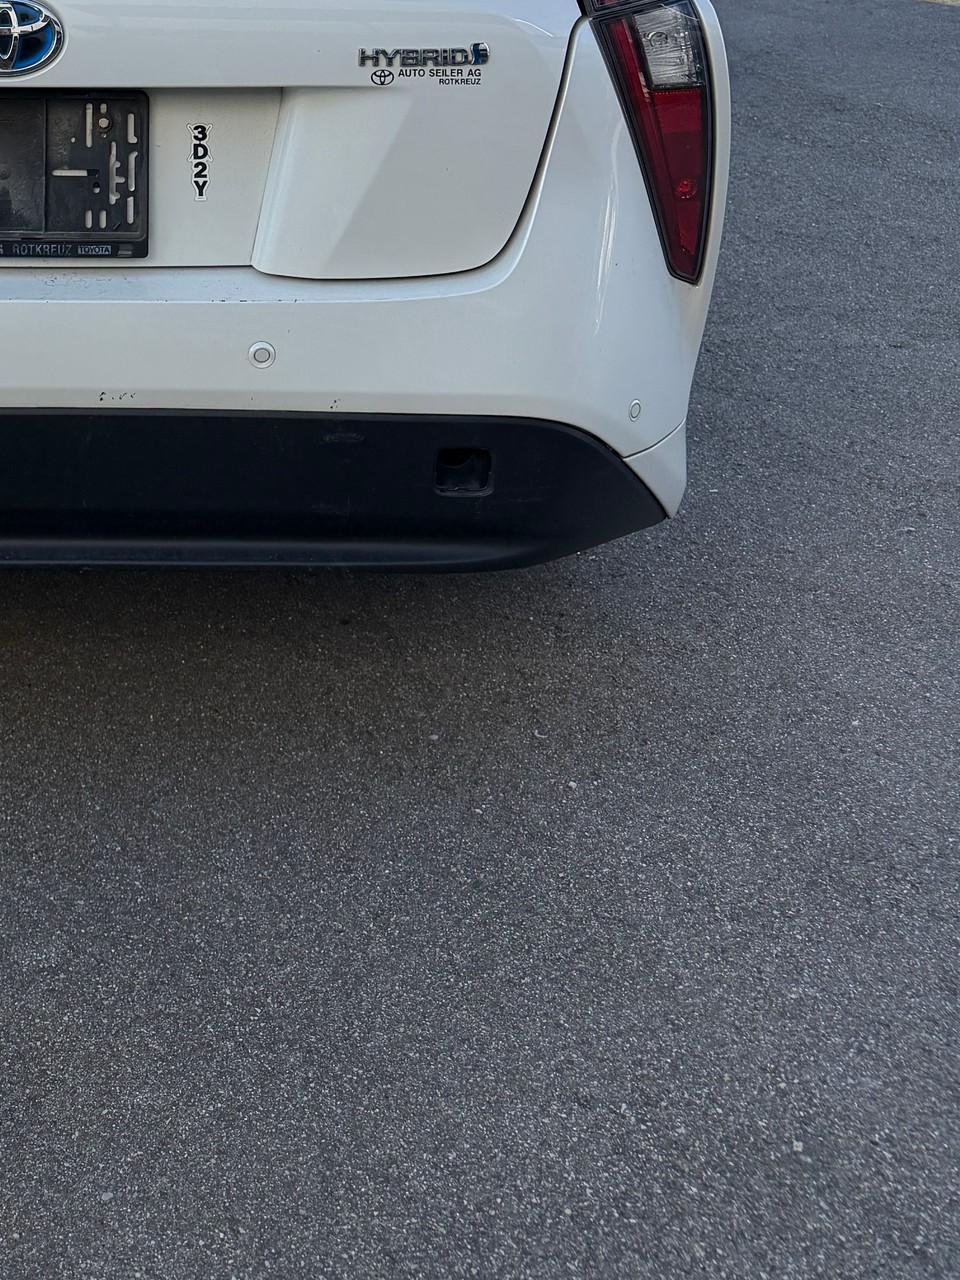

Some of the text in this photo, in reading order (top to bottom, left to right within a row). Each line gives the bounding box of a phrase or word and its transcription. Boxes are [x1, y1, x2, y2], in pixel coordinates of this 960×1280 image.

[358, 47, 469, 67] HYBRID
[398, 69, 481, 77] AUTO SEILER AG
[12, 243, 72, 256] ROTKREUZ
[79, 245, 111, 255] TOYOTA
